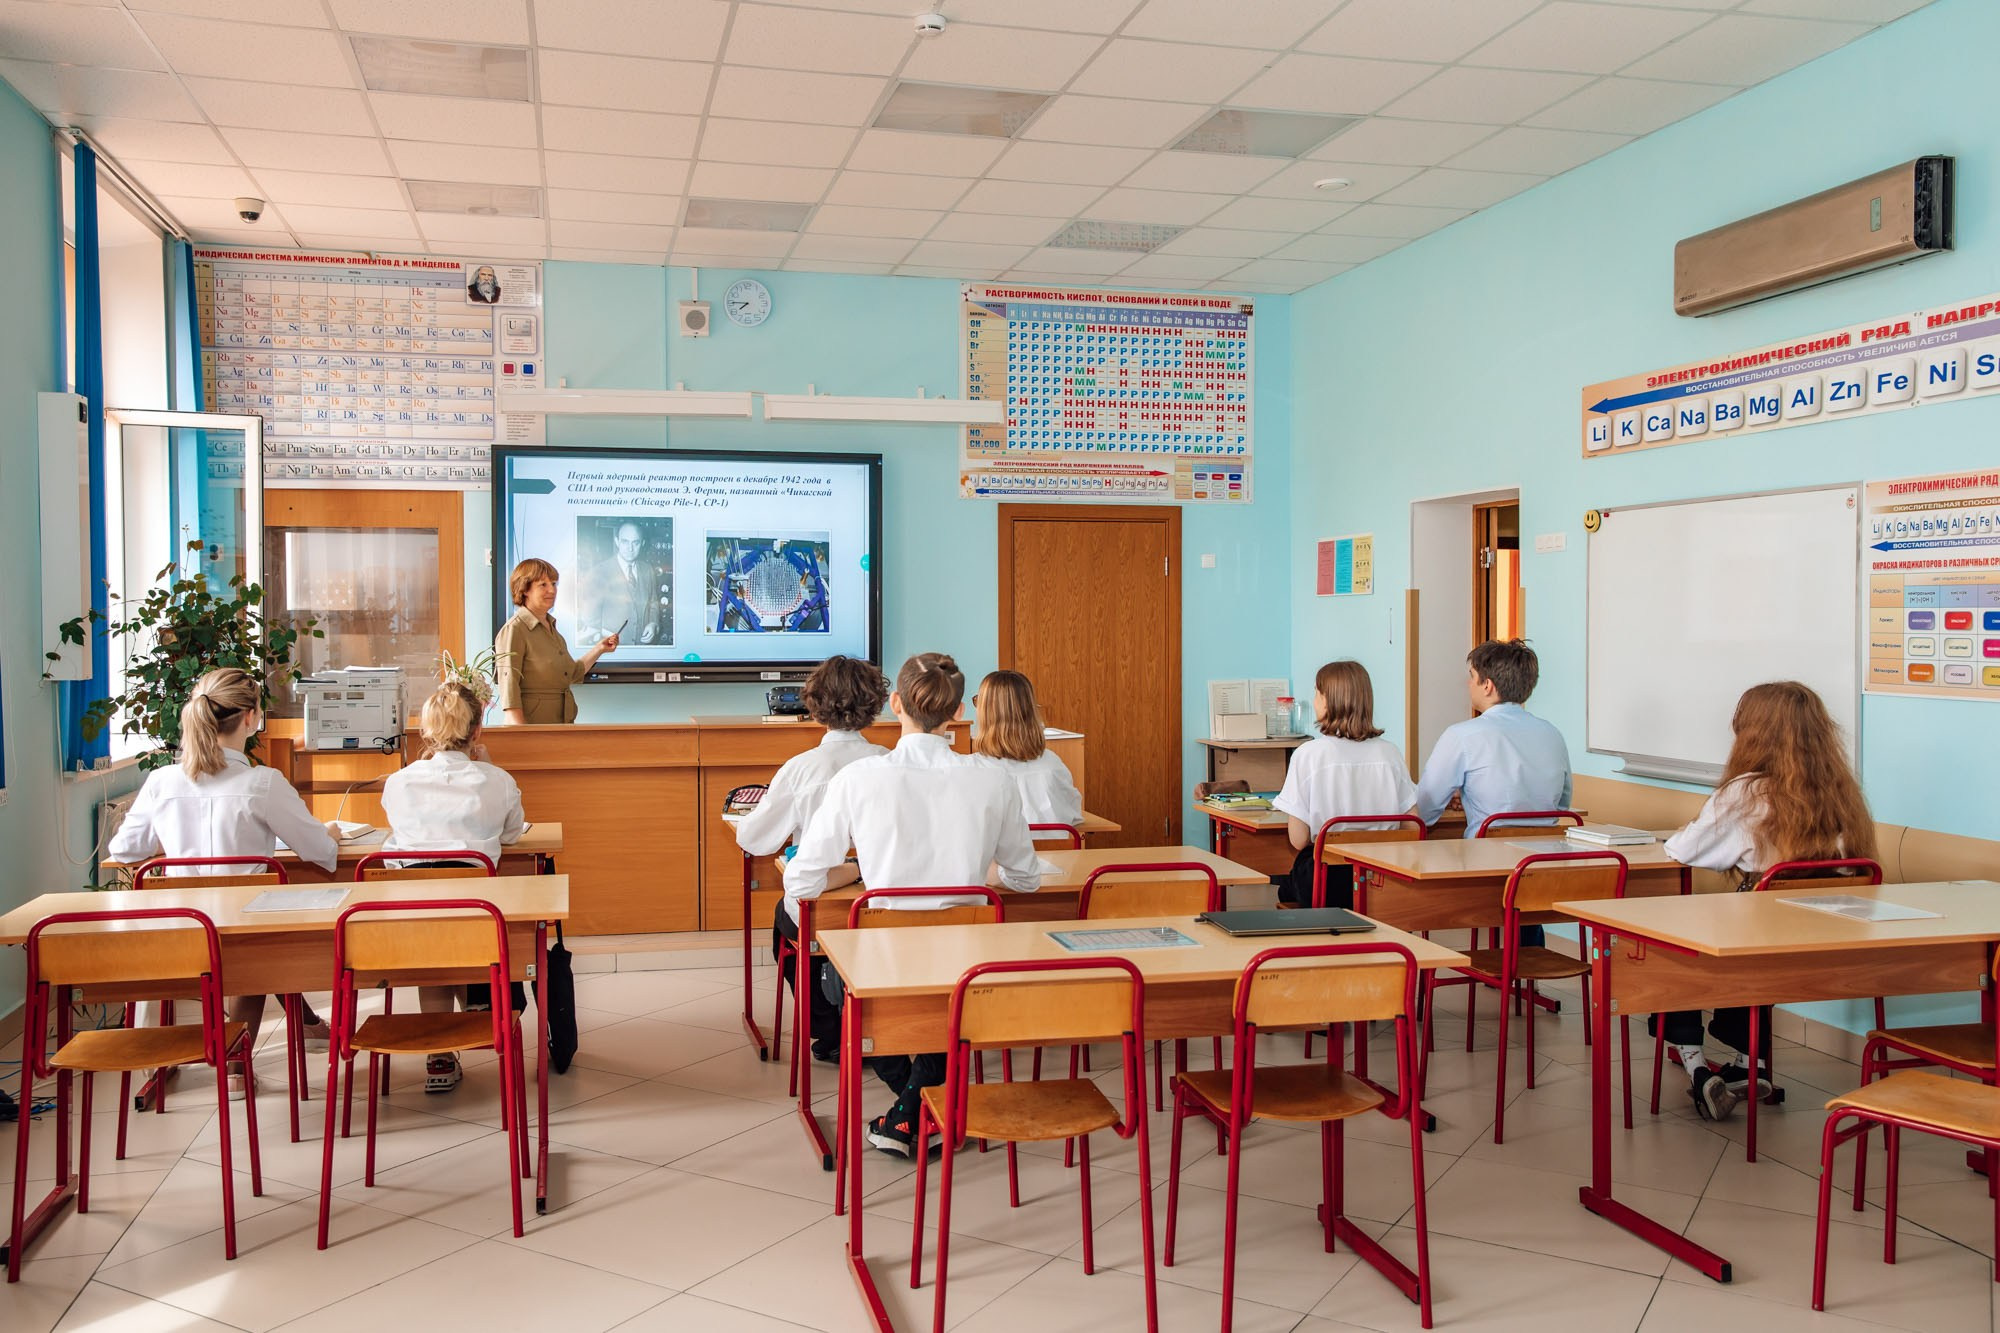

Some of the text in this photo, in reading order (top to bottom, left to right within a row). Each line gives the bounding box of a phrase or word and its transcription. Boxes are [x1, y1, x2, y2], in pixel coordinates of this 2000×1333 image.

[193, 250, 253, 260] РИОДИЧЕСКАЯ
[255, 253, 291, 261] СИСТЕМА
[293, 255, 345, 264] ХИМИЧЕСКИХ
[346, 257, 391, 266] ЭЛЕМЕНТОВ
[394, 260, 402, 268] Д.
[412, 261, 460, 270] МЕНДЕЛЕЕВА
[743, 282, 752, 290] 12
[760, 299, 768, 307] 3
[985, 289, 1064, 301] РАСТВОРИМОСТЬ
[1162, 297, 1169, 305] И
[1170, 297, 1198, 307] СОЛЕЙ
[1200, 299, 1206, 307] В
[1208, 299, 1232, 309] ВОДЕ
[1647, 332, 1850, 387] ЭЛЕКТРОХИМИЧЕСКИЙ
[1861, 320, 1911, 343] РЯД
[1685, 367, 1780, 394] ВОССТАНОВИТЕЛЬНАЯ
[1781, 353, 1855, 374] СПОСОБНОСТЬ
[1593, 353, 2000, 441] Li K Ca Na Ba Mg Al Zn Fe Ni S
[567, 471, 604, 482] Первый
[606, 472, 646, 483] ядерный
[647, 474, 687, 484] реактор
[689, 475, 733, 485] построен
[743, 475, 778, 485] декабре
[780, 475, 801, 484] 1942
[1025, 477, 1035, 485] Mg
[1125, 480, 1134, 488] Hg
[1136, 480, 1146, 488] Ag
[1888, 474, 1999, 495] ЭЛЕКТРОХИМИЧЕСКИЙ РЯД
[567, 484, 593, 492] США
[614, 486, 679, 495] руководством
[682, 486, 691, 494] Э.
[694, 486, 727, 496] Ферми,
[729, 488, 778, 496] названный
[630, 497, 671, 508] (Chicago
[673, 498, 701, 508] Pile-1,
[1893, 501, 1961, 512] ОКИСЛИТЕЛЬНАЯ
[1873, 524, 1880, 534] Li
[1886, 522, 1892, 533] K
[1896, 522, 1907, 531] Ca
[1909, 521, 1920, 531] Na
[1923, 520, 1933, 530] Ba
[1936, 519, 1948, 531] Mg
[1951, 518, 1960, 528] Al
[1965, 517, 1976, 528] Zn
[1979, 516, 1990, 527] Fe
[1892, 539, 1973, 549] ВОССТАНОВИТЕЛЬНАЯ
[1872, 557, 2000, 570] ОКРАСКА ИНДИКАТОРОВ В РАЗЛИЧНЫХ СР
